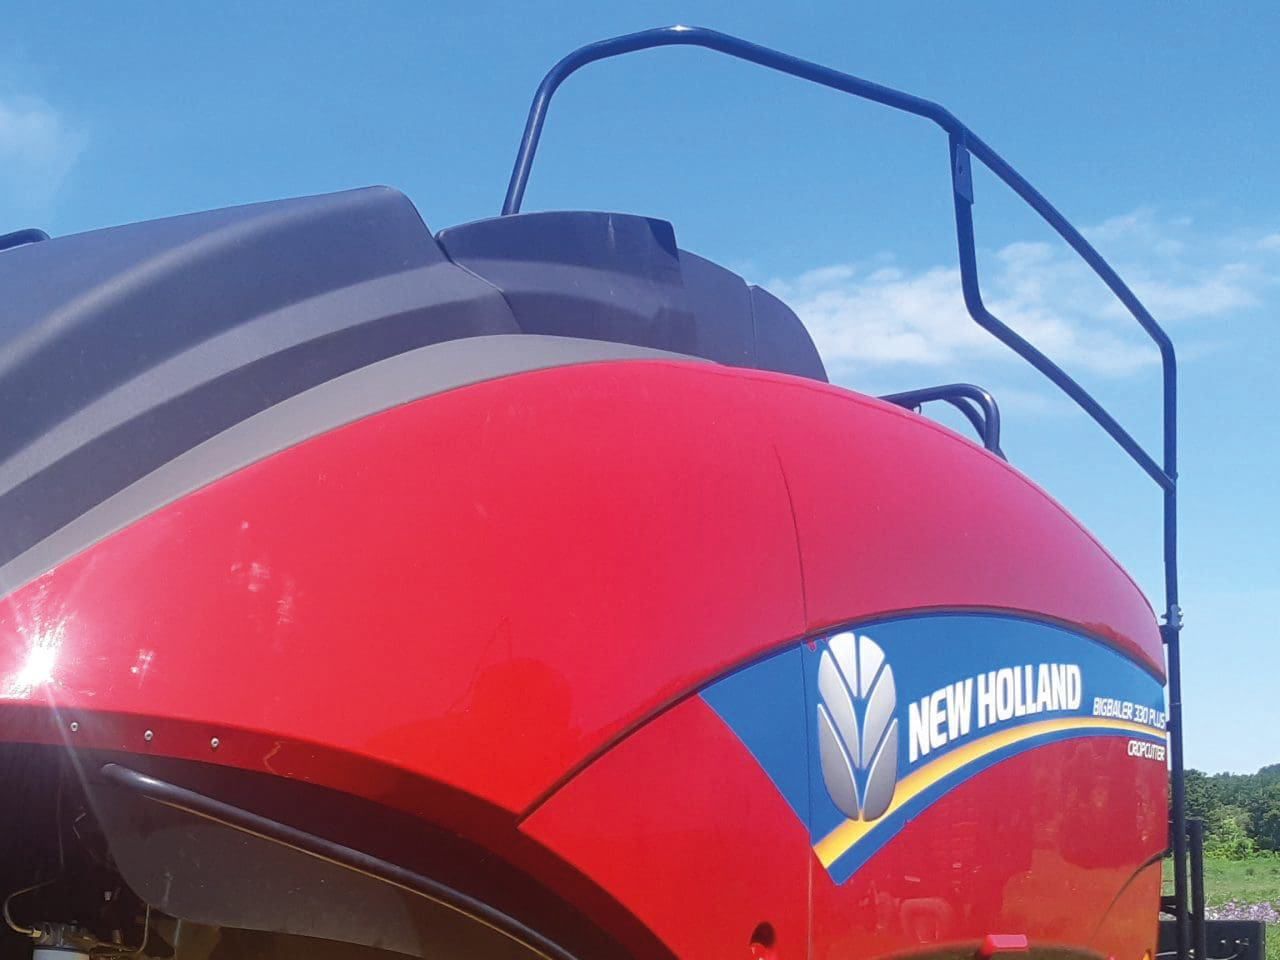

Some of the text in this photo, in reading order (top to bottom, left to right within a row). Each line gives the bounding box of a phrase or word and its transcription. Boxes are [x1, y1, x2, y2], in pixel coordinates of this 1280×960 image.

[908, 663, 1081, 763] NEW HOLLAND
[1093, 697, 1166, 729] BIGBALER 330 PLUS
[1127, 740, 1165, 761] CROPCUTTER
